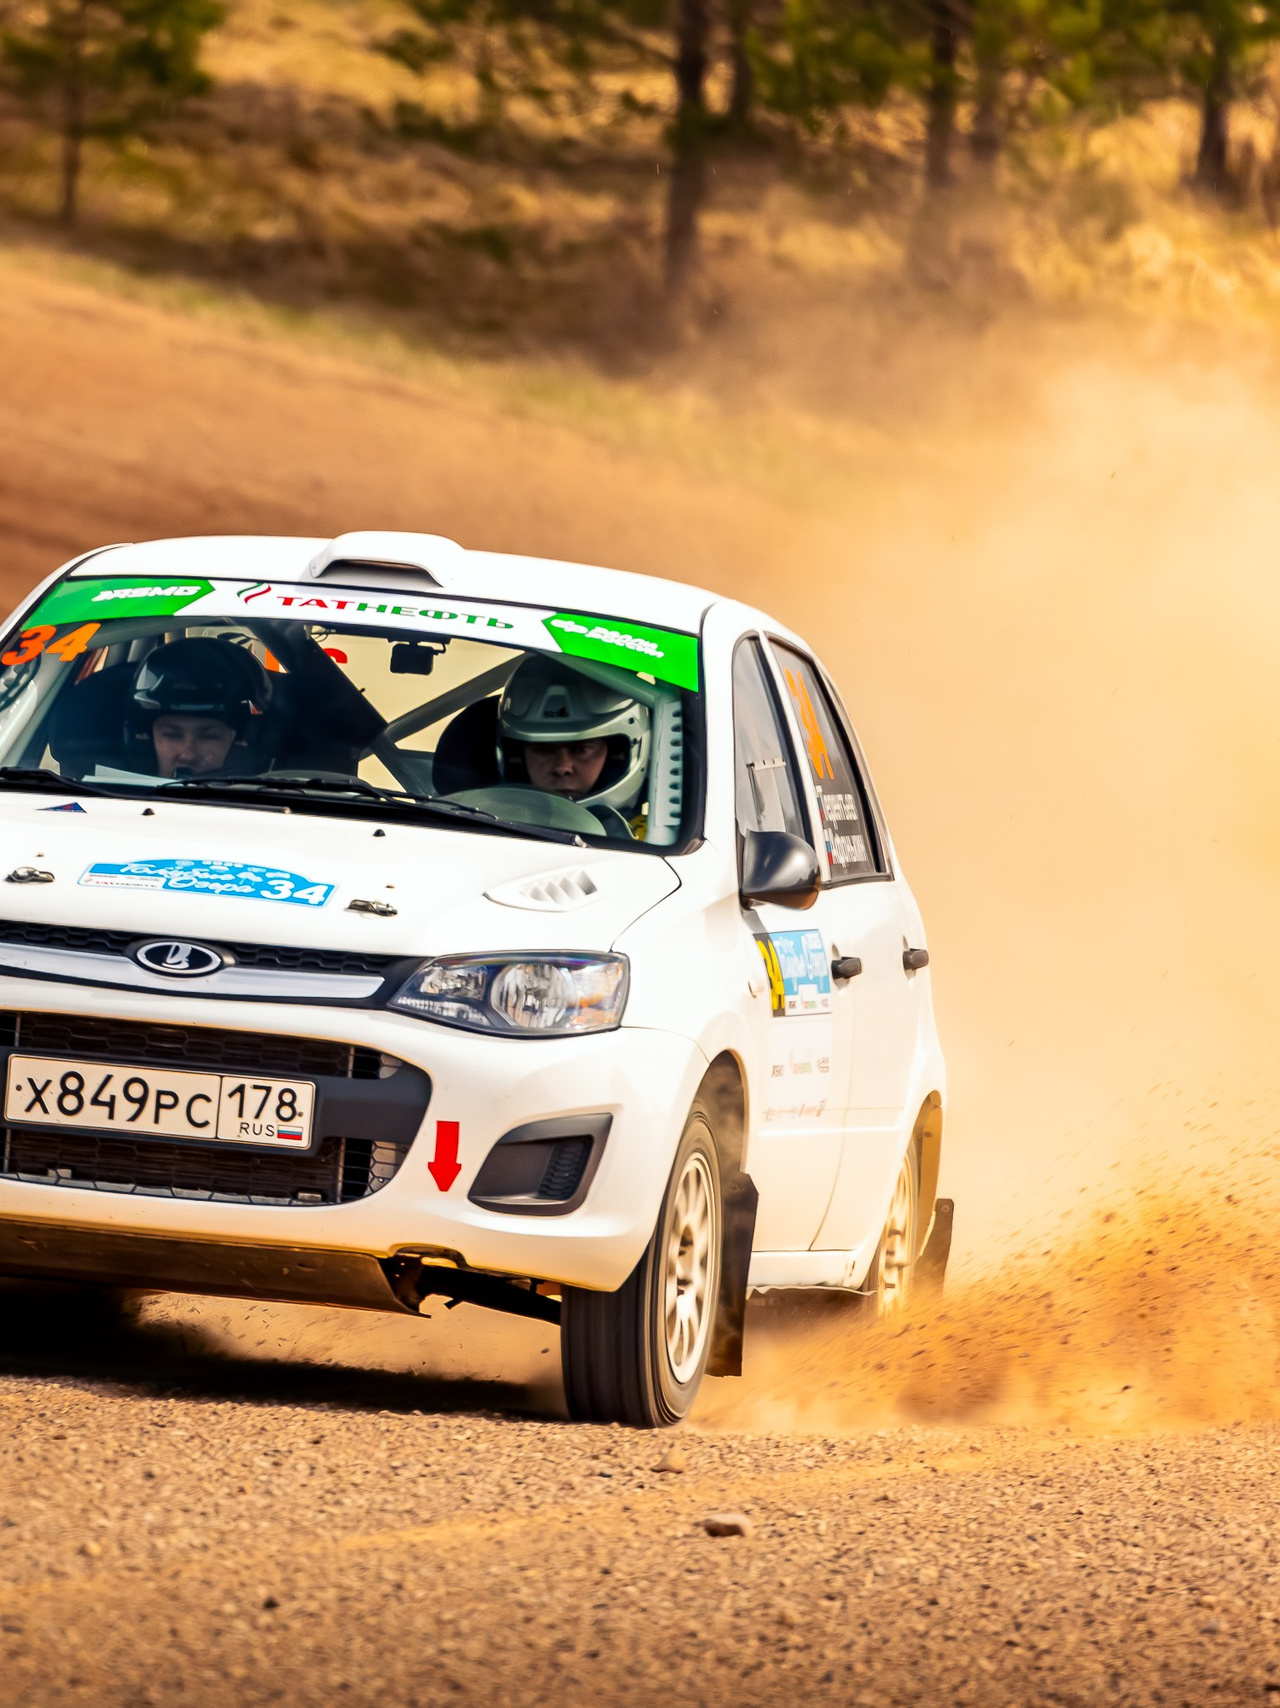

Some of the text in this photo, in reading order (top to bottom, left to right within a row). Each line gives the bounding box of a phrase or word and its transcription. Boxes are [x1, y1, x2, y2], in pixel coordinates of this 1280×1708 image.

[276, 596, 515, 629] ТАТНЕФТЬ
[1, 622, 101, 666] 34
[260, 879, 329, 905] 34
[227, 1083, 297, 1122] 178
[238, 1122, 275, 1137] RUS
